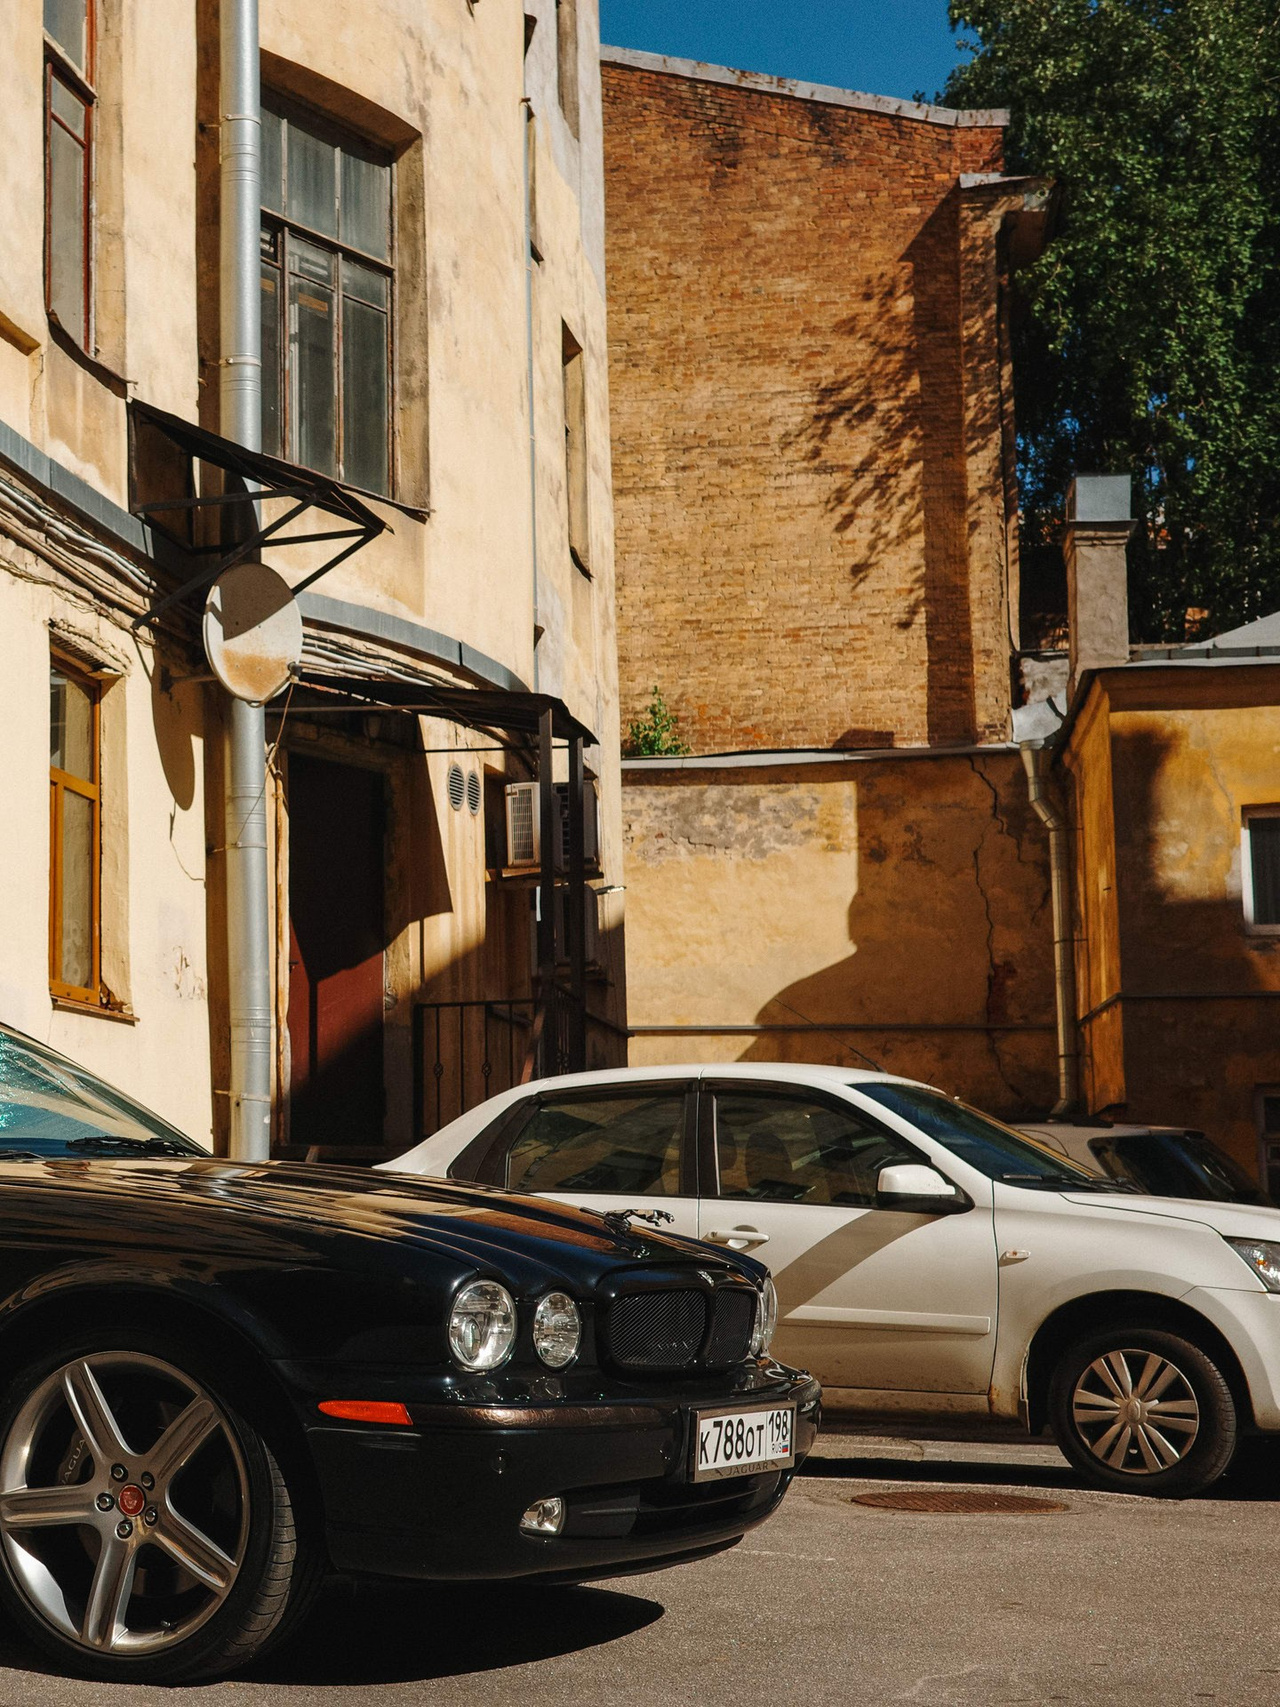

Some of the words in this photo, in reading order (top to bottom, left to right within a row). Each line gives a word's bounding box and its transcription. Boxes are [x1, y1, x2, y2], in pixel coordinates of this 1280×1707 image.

[768, 1410, 789, 1443] 198
[771, 1442, 782, 1454] RUS
[726, 1461, 769, 1476] JAGUAR
